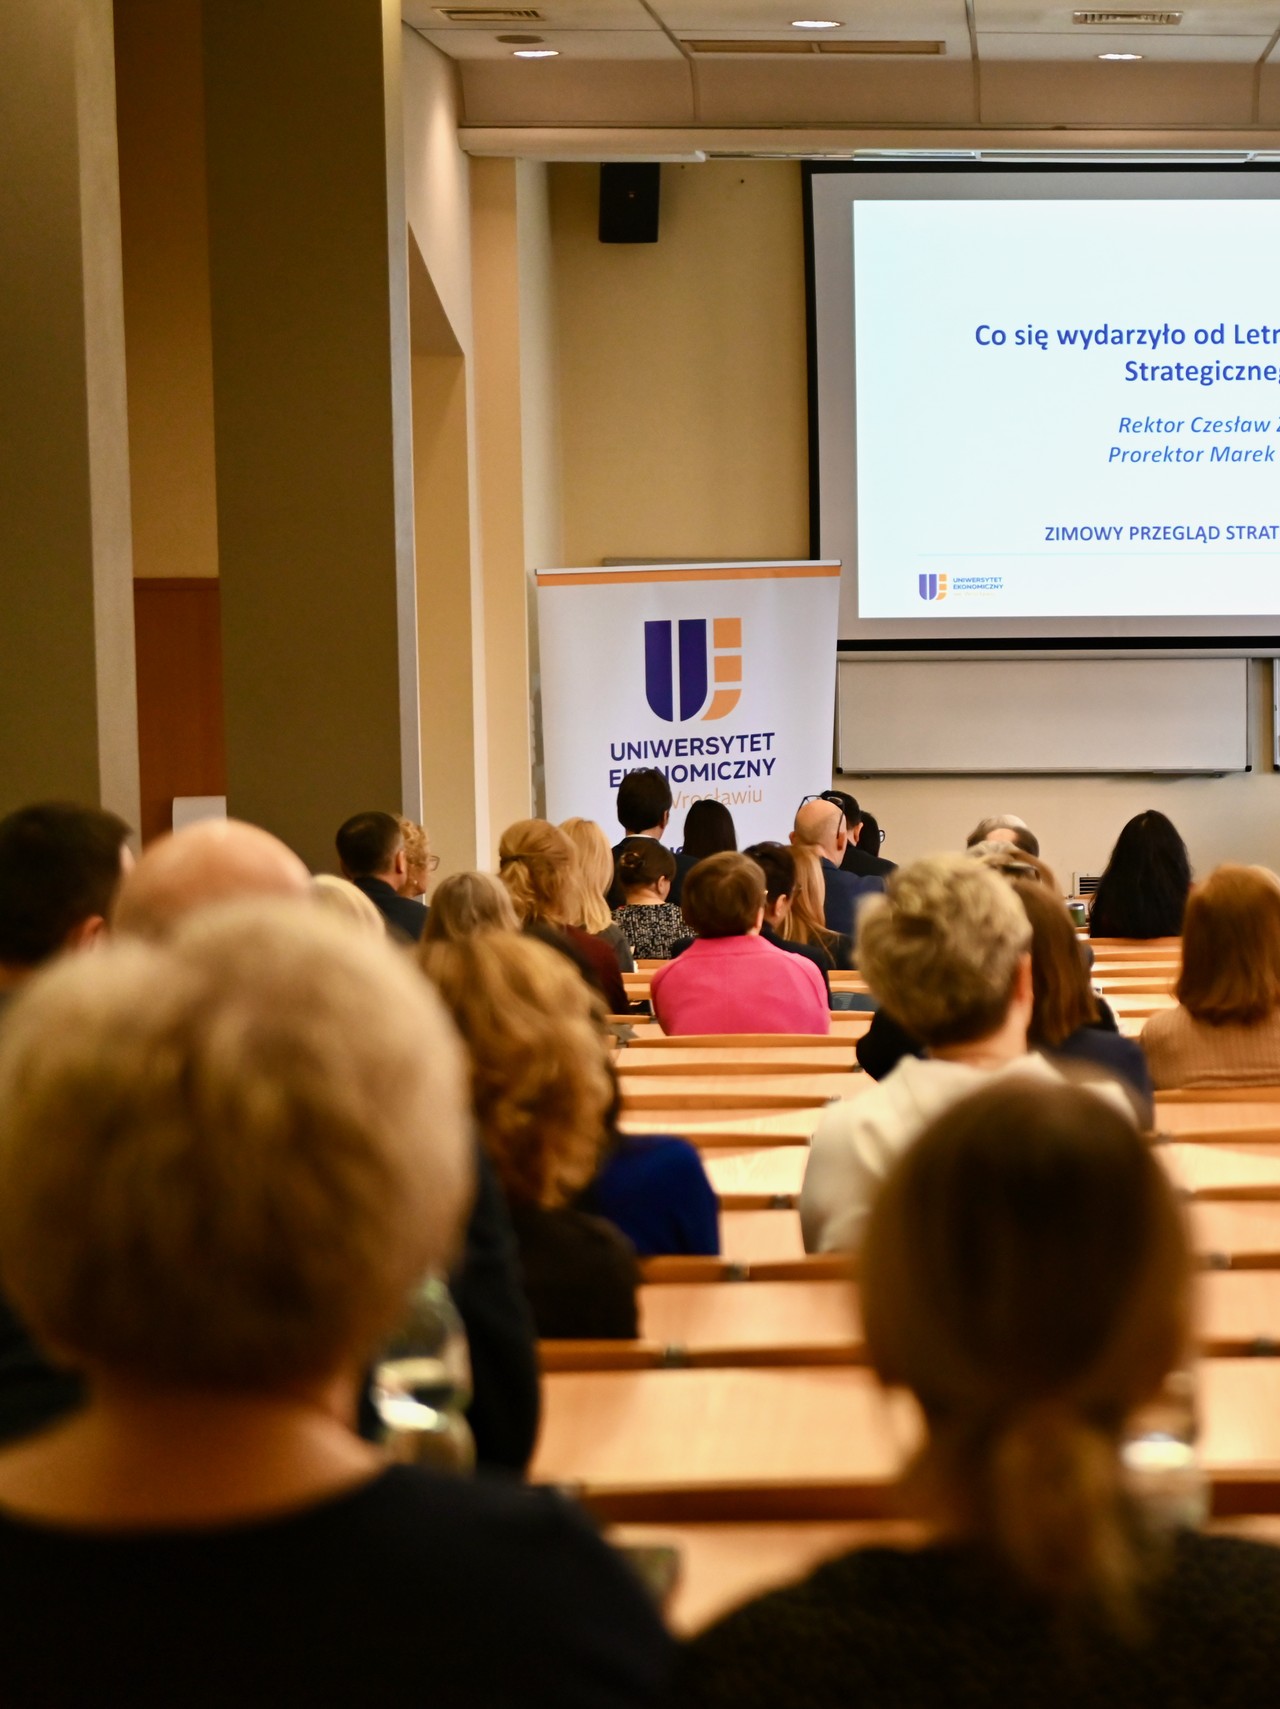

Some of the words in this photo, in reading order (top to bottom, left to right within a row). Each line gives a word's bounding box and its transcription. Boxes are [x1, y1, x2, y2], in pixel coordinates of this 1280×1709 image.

[975, 325, 1007, 346] Co
[1015, 323, 1049, 351] się
[1057, 322, 1186, 350] wydarzyło
[1194, 322, 1225, 345] od
[1118, 416, 1185, 434] Rektor
[1190, 416, 1271, 434] Czesław
[1108, 445, 1205, 463] Prorektor
[1209, 445, 1276, 463] Marek
[1044, 525, 1124, 542] ZIMOWY
[1129, 525, 1221, 544] PRZEGLĄD
[610, 732, 776, 761] UNIWERSYTET
[609, 757, 776, 788] ENOMICZNY
